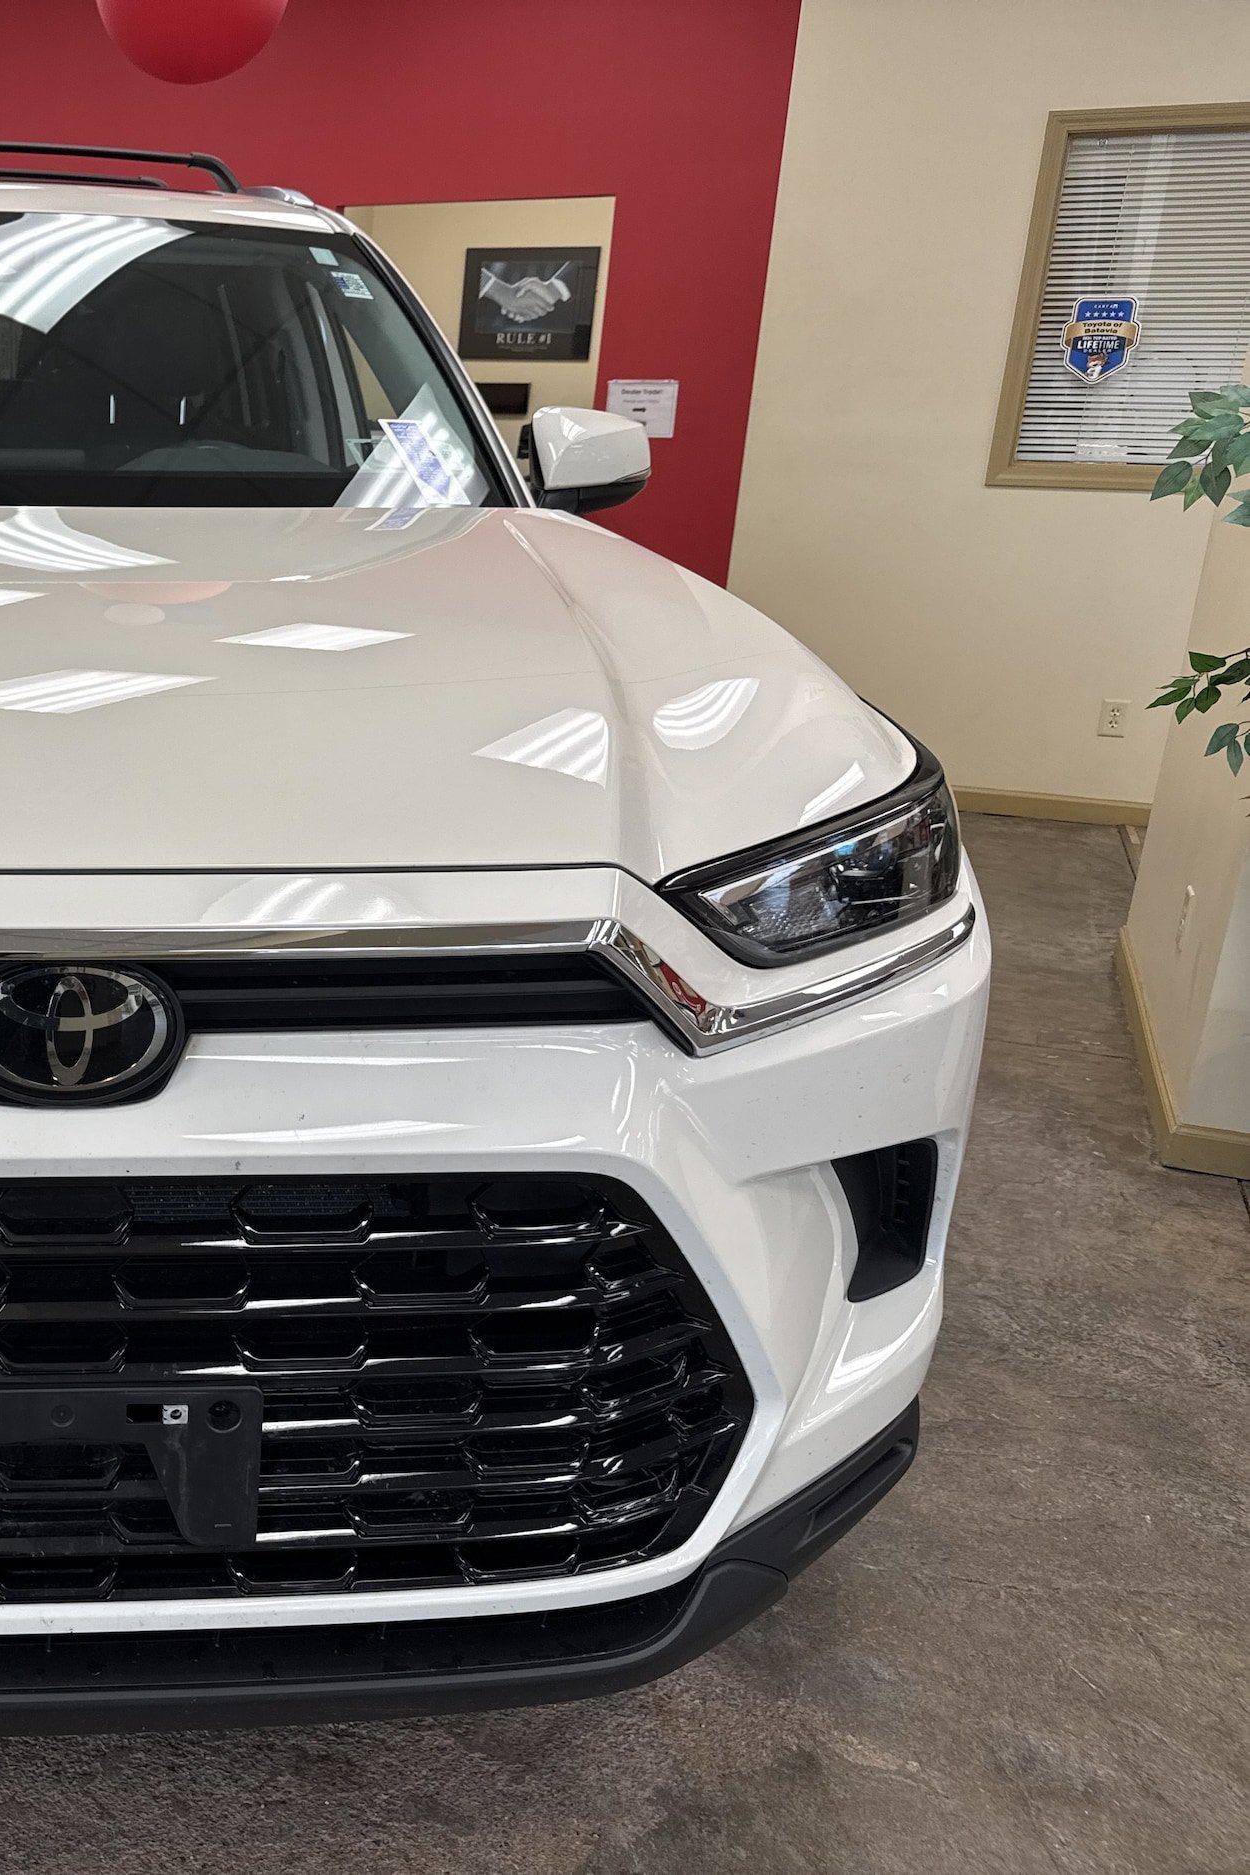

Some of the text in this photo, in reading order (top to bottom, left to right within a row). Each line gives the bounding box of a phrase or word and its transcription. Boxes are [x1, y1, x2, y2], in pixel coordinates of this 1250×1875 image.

[496, 332, 551, 344] RULE #1
[1077, 340, 1120, 349] LIFETIME
